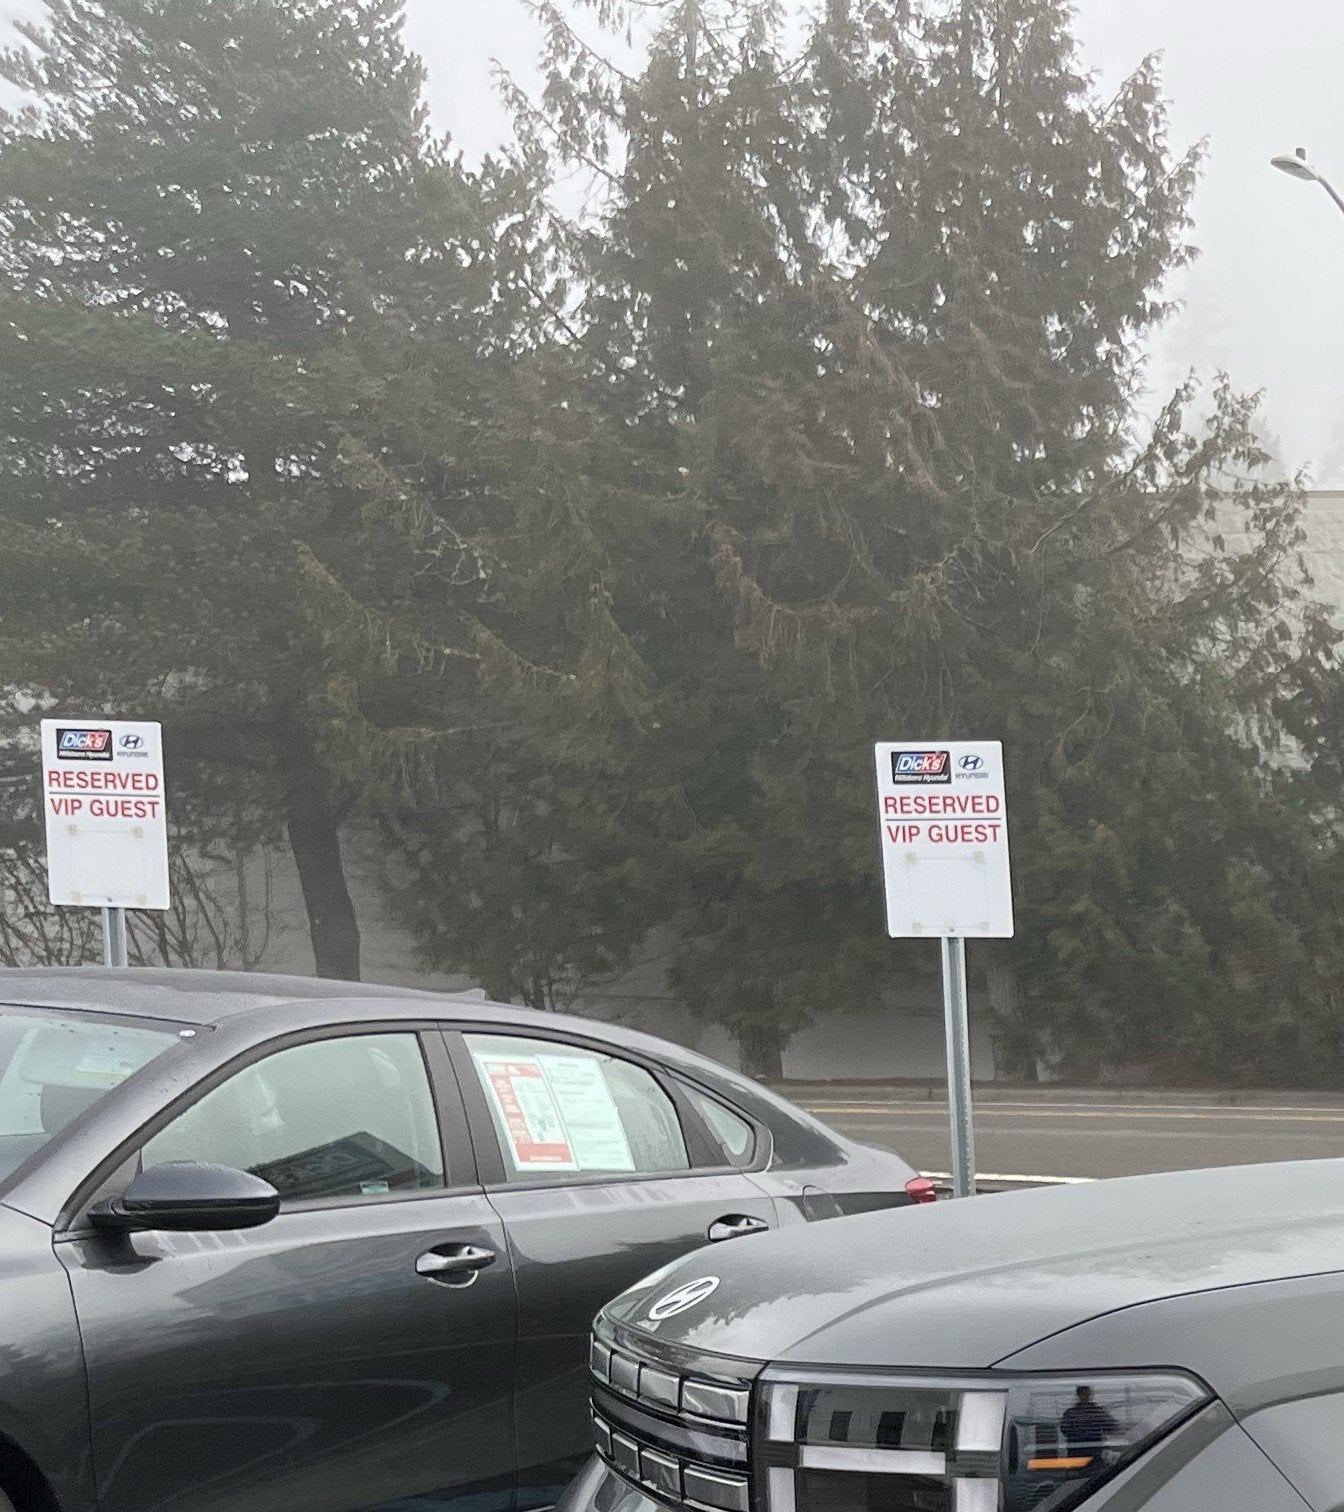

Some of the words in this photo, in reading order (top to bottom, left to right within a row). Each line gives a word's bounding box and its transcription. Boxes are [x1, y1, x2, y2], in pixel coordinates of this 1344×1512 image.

[48, 770, 158, 791] RESERVED
[51, 798, 82, 816] VIP
[90, 798, 160, 819] GUEST
[884, 795, 1000, 815] RESERVED
[887, 825, 921, 844] VIP
[928, 824, 1001, 844] GUEST
